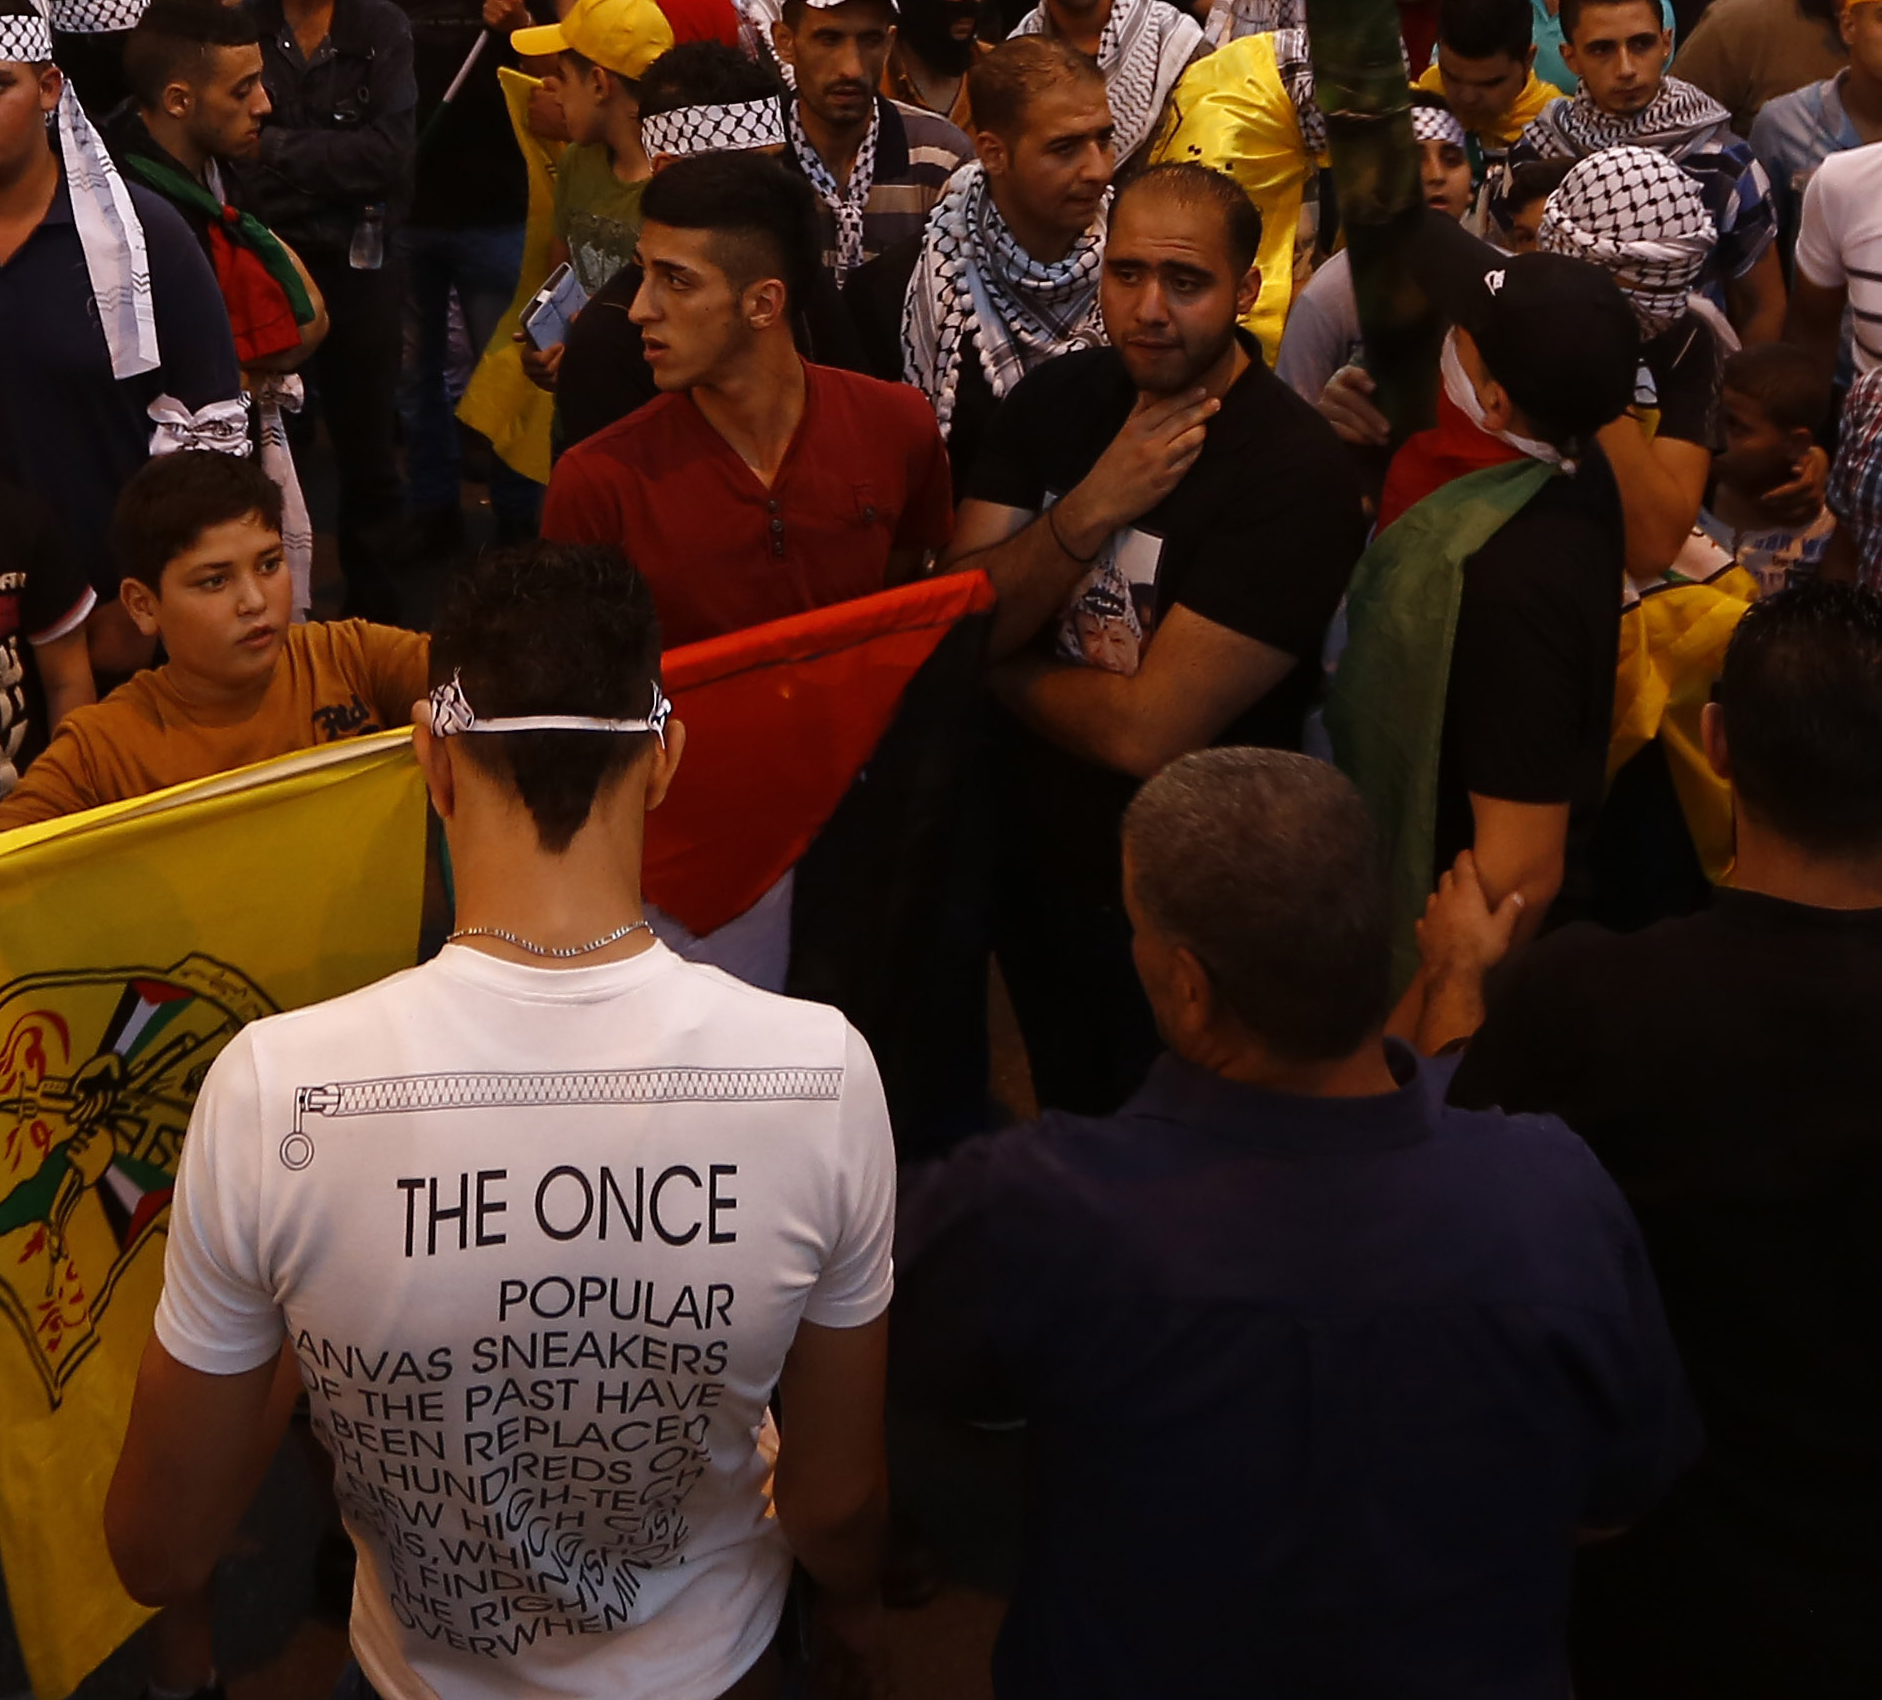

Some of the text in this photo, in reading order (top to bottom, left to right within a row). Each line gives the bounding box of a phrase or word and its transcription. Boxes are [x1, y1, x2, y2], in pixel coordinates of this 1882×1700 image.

[396, 1163, 739, 1258] THE ONCE
[498, 1275, 735, 1331] POPULAR
[296, 1328, 729, 1386] ANVAS SNEAKERS
[357, 1387, 445, 1424] THE
[465, 1377, 580, 1423] PAST
[595, 1377, 726, 1415] HAVE
[329, 1408, 446, 1461] BEEN
[463, 1413, 712, 1467] REPLACED
[378, 1451, 633, 1507] HUNDREDS
[419, 1531, 586, 1599] FINDING
